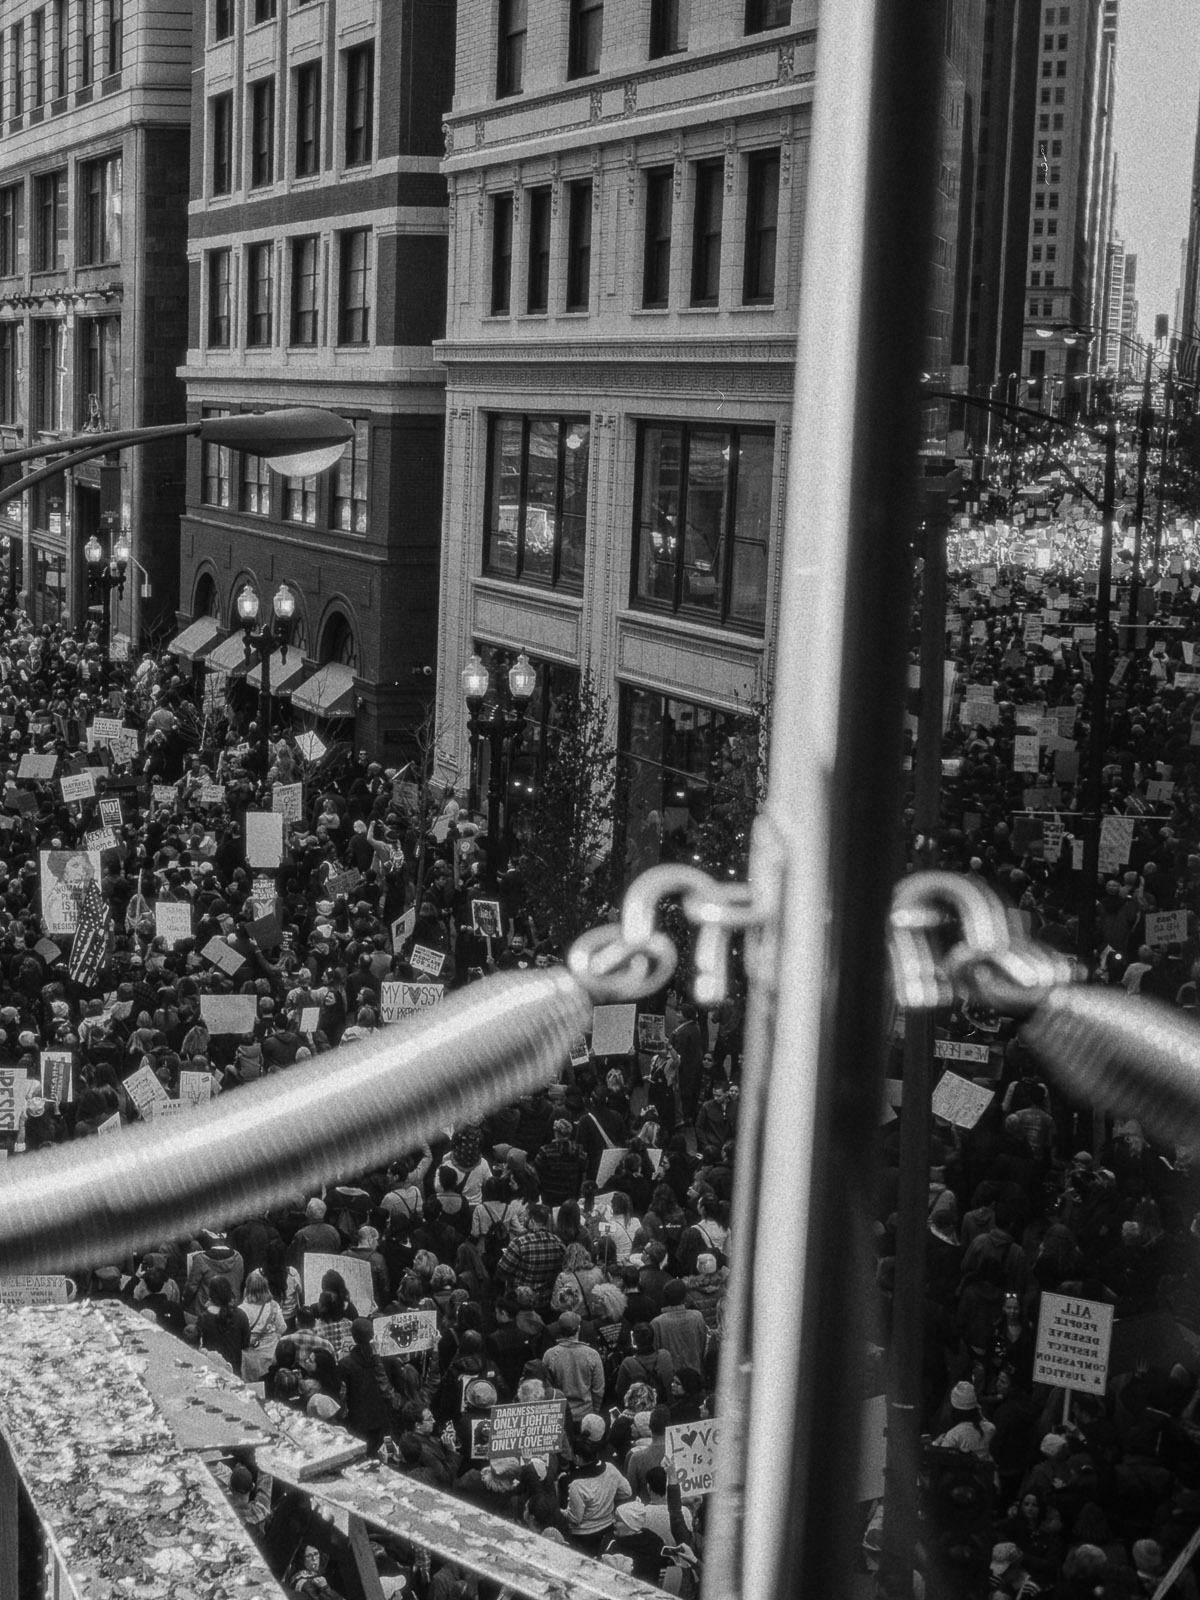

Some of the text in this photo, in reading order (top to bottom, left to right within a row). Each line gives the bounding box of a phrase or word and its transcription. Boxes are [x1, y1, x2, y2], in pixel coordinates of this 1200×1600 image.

[102, 802, 119, 814] NO!
[87, 827, 113, 841] RESPEC
[63, 911, 78, 922] TH
[53, 922, 76, 930] RESIST
[382, 985, 399, 1004] MY
[382, 1006, 394, 1020] MY
[493, 1417, 518, 1430] ONLY
[520, 1414, 548, 1428] LIGHT
[505, 1428, 525, 1438] DRIVE
[527, 1426, 541, 1435] OUT
[492, 1438, 517, 1451] ONLY
[519, 1435, 543, 1449] LOVE
